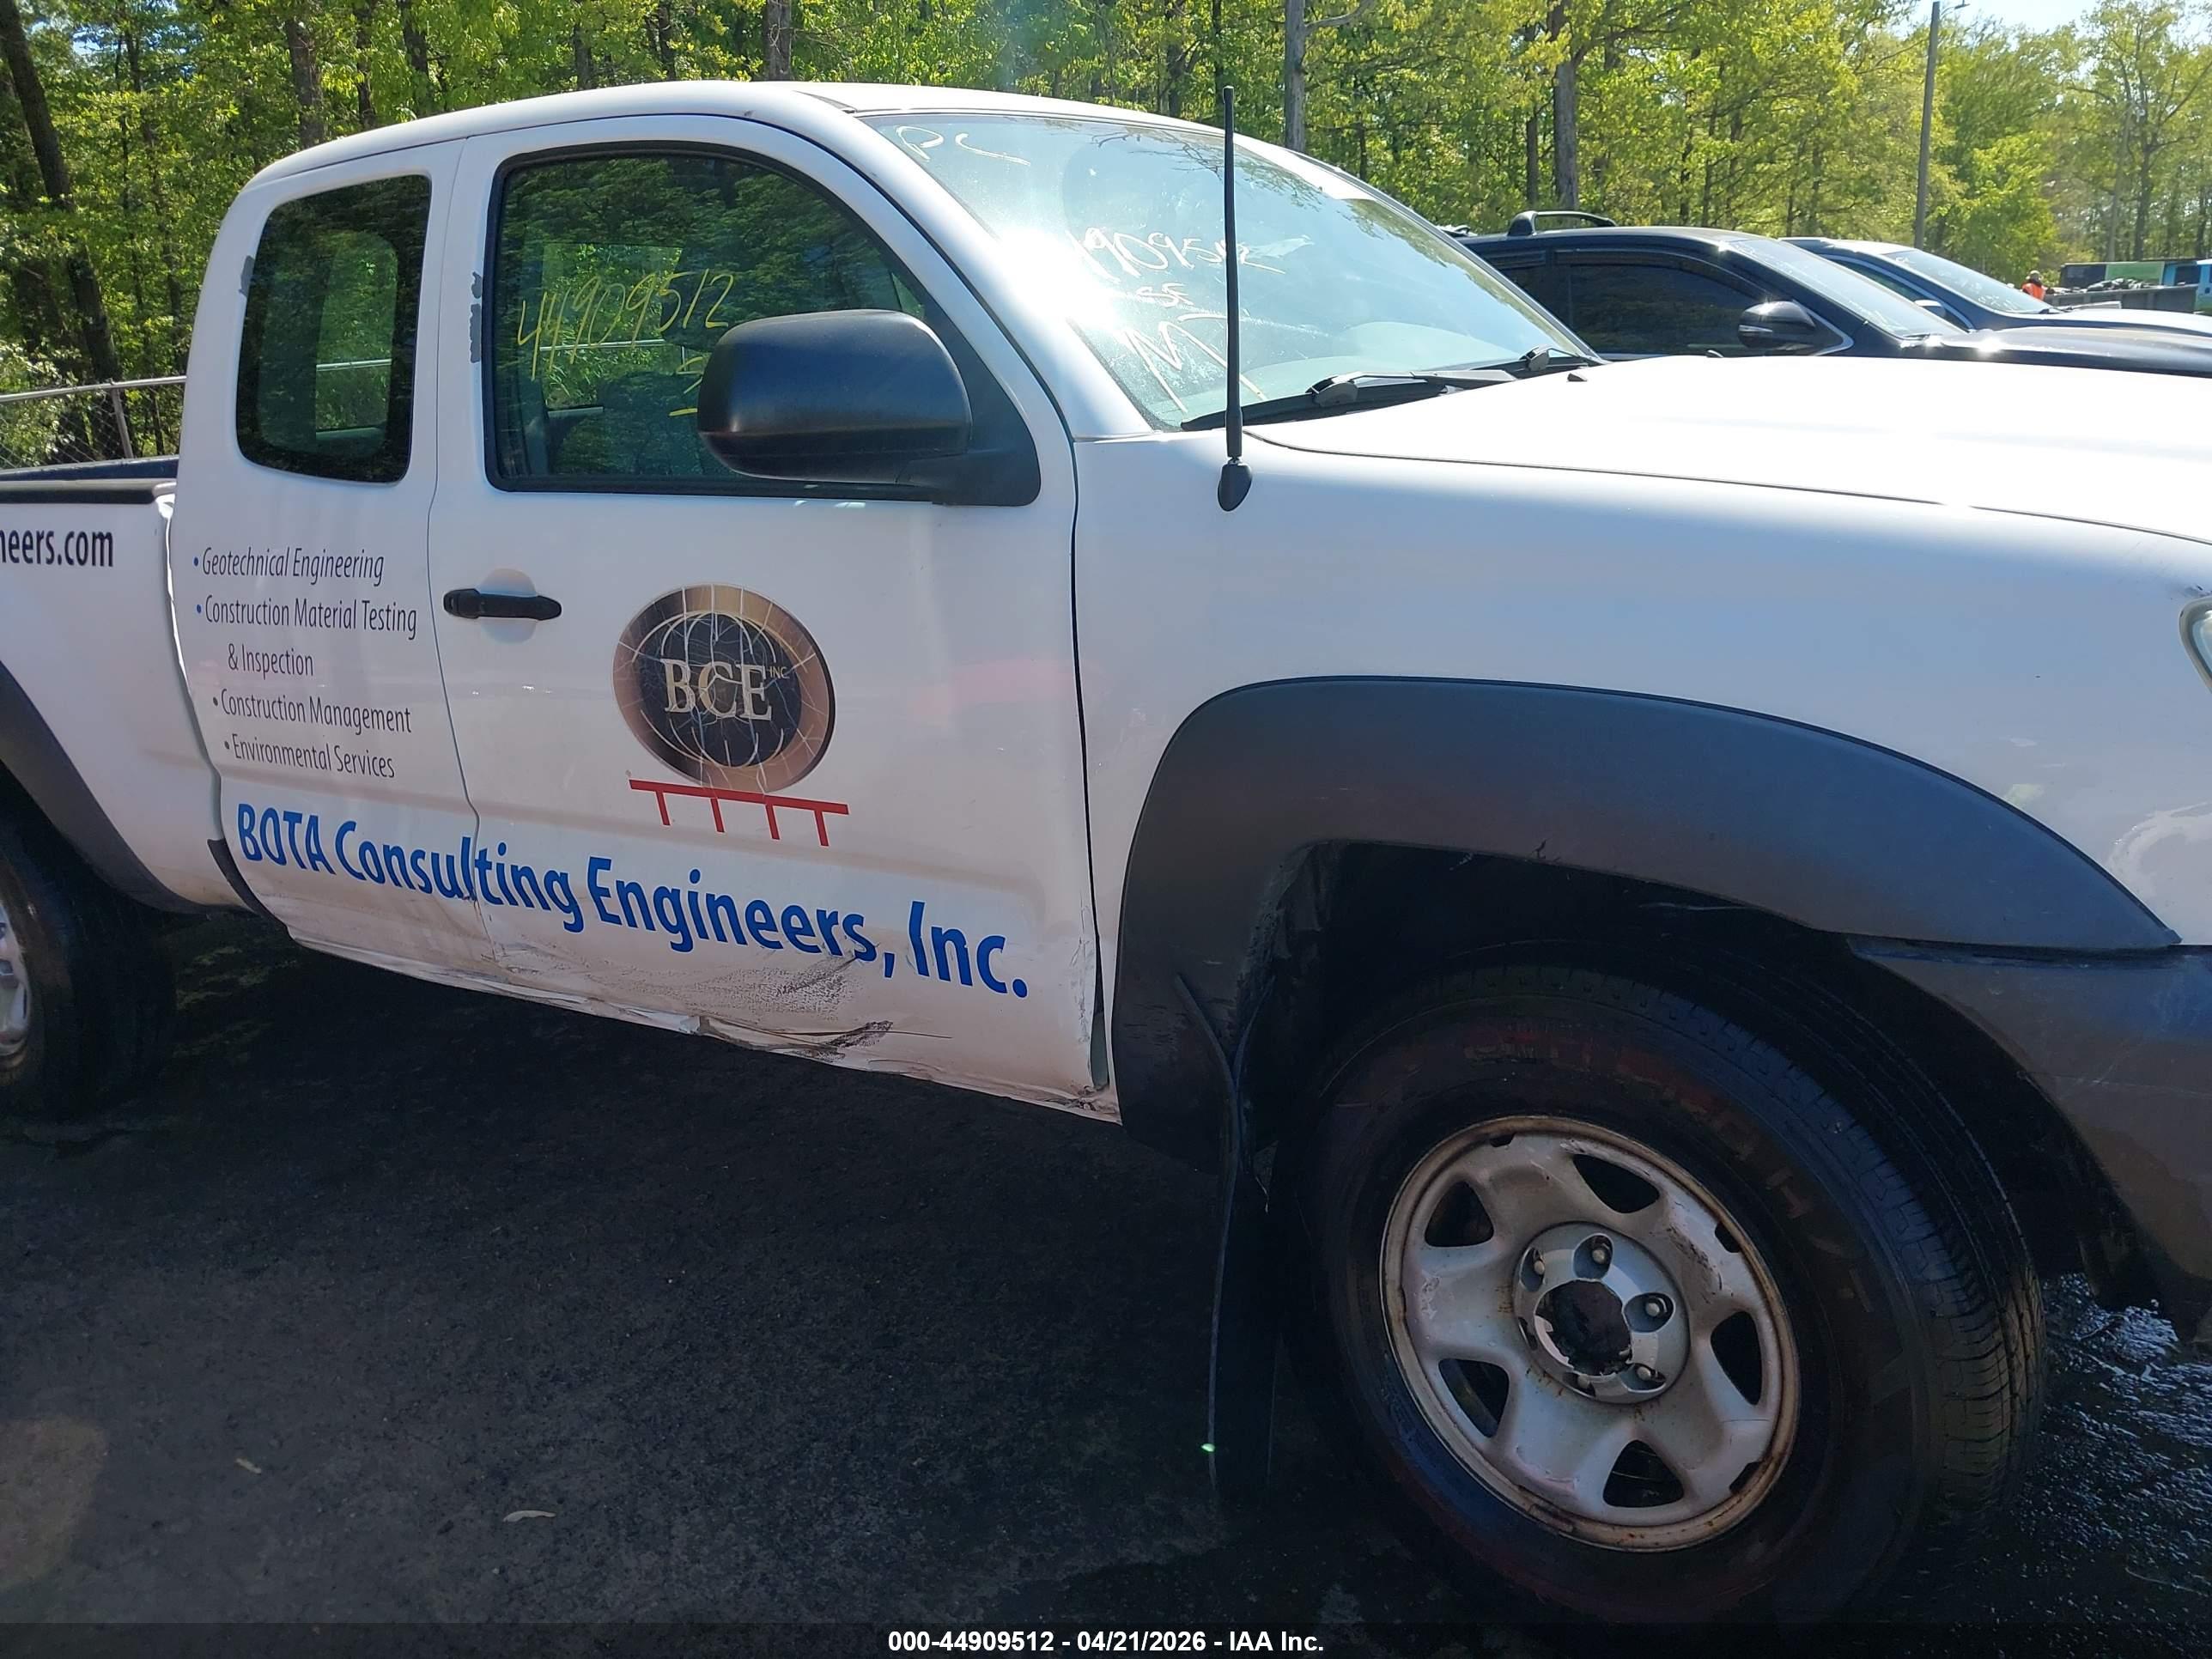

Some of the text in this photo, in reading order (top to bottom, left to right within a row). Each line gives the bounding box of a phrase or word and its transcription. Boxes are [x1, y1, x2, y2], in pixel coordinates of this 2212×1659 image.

[202, 546, 385, 587] Geotechnical Engineering
[204, 595, 418, 641] Construction Material Testing
[228, 642, 314, 678] & Inspection
[221, 688, 412, 736] Construction Management
[659, 657, 773, 721] BCE
[231, 733, 396, 780] Environmental Services
[237, 803, 1029, 999] BOTA Consulting Engineers, Inc.
